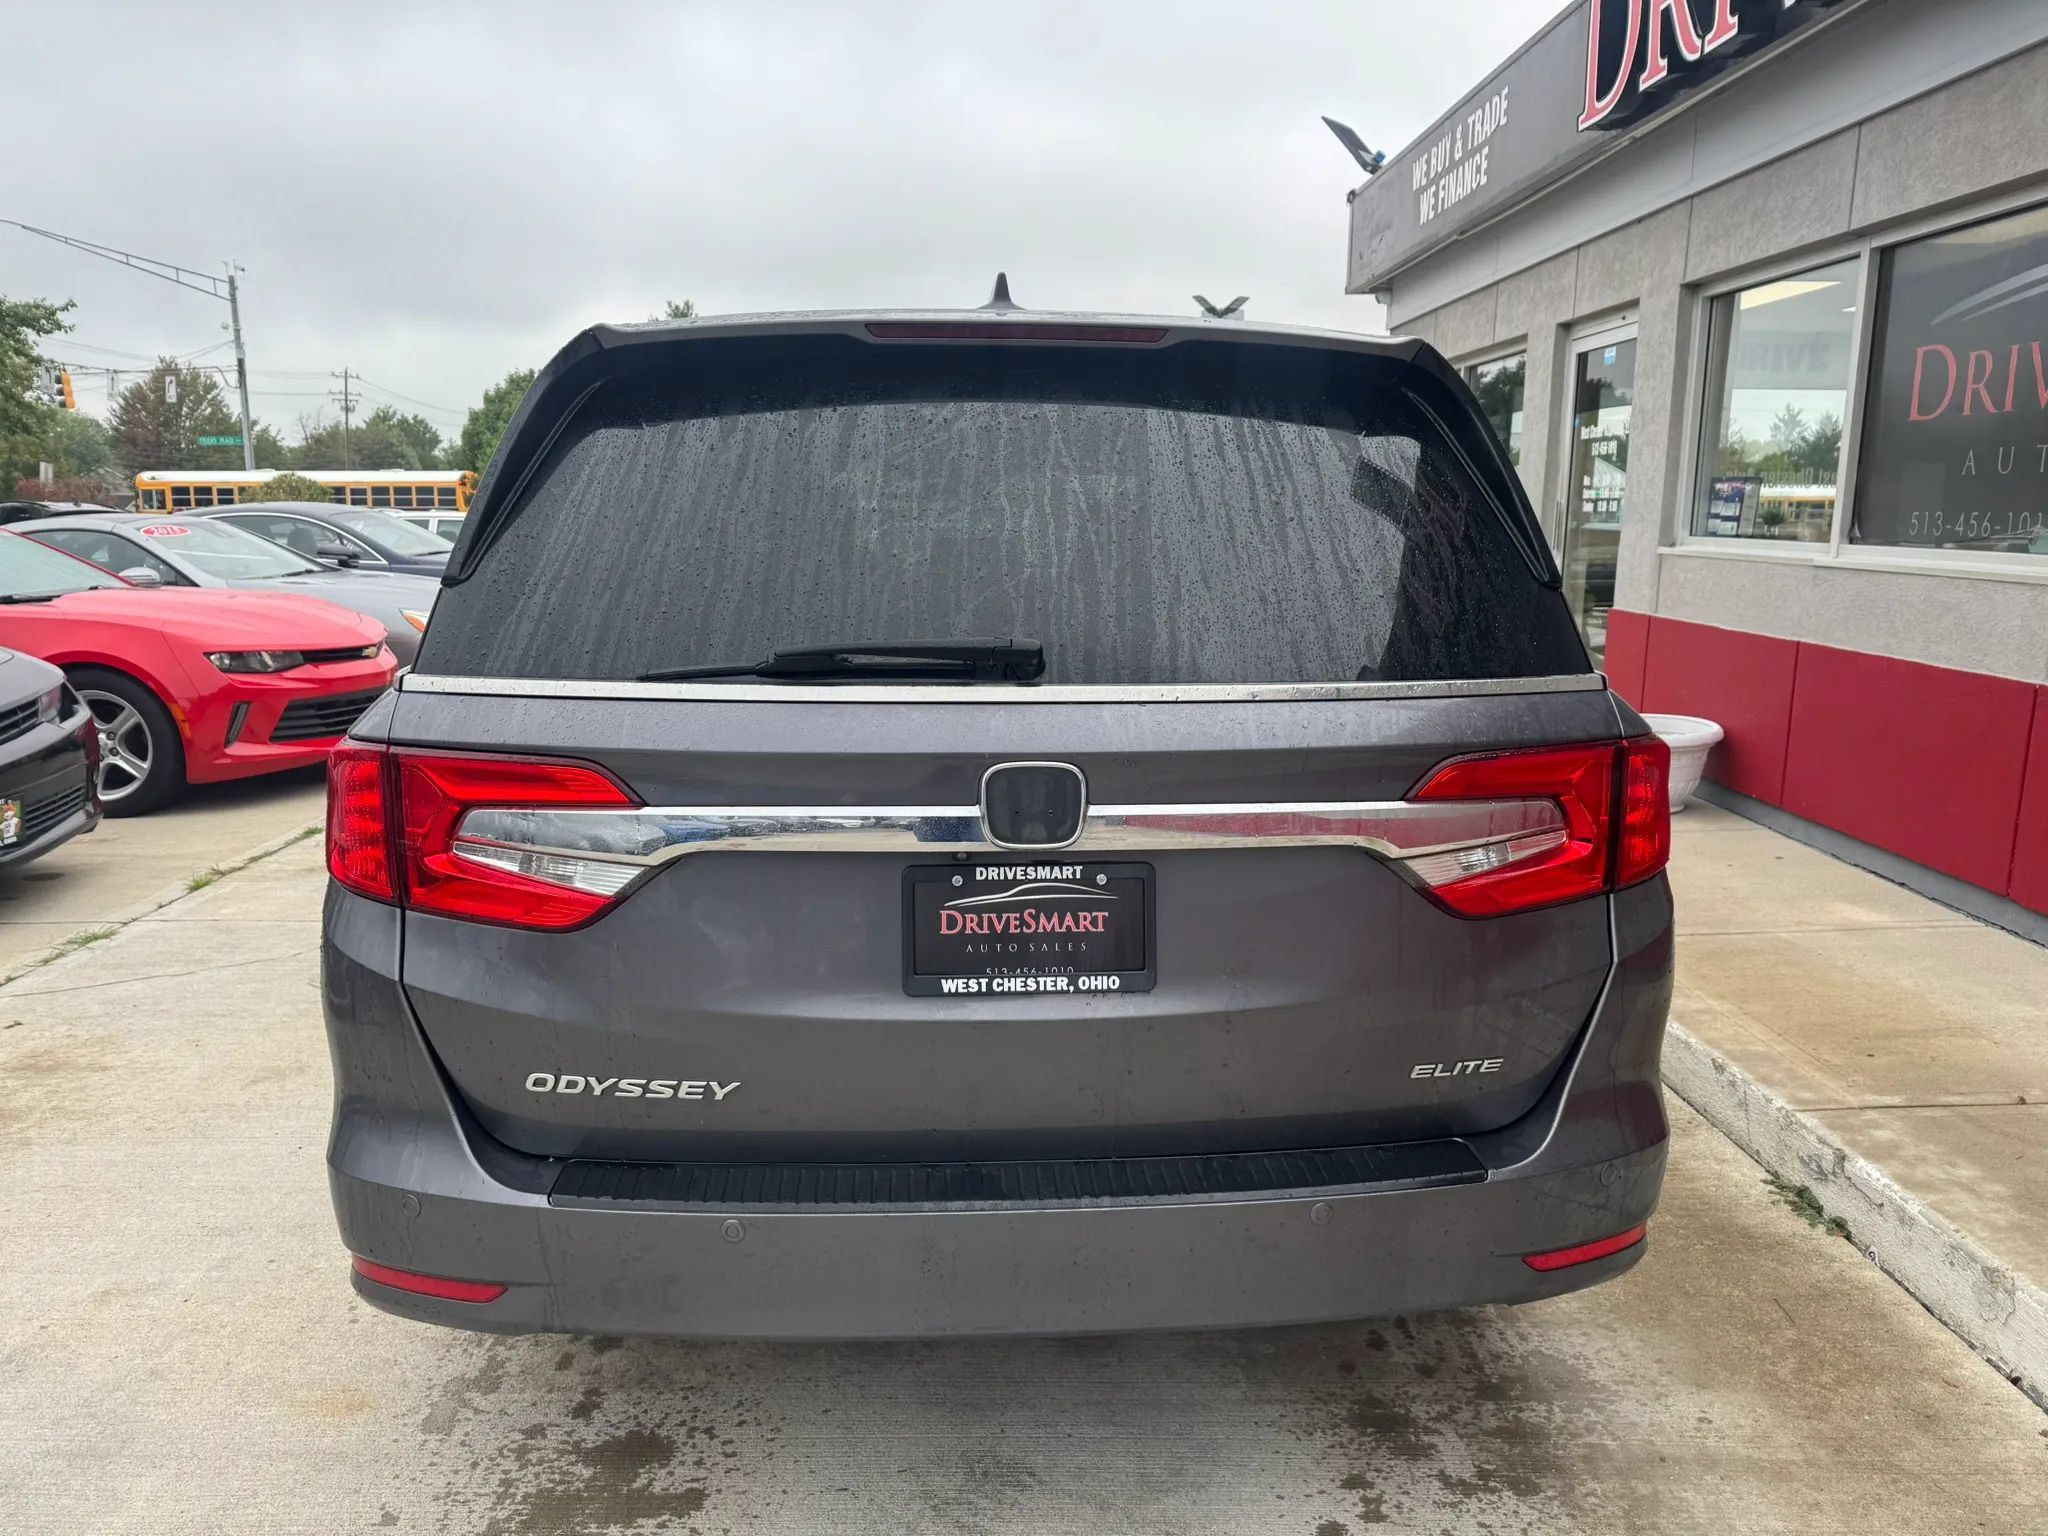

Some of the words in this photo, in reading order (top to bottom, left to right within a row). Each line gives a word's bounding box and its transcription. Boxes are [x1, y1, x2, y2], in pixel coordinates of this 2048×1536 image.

[1412, 153, 1428, 191] WE
[1429, 131, 1452, 179] BUY
[1454, 123, 1463, 161] &
[1467, 84, 1509, 150] TRADE
[1419, 184, 1437, 226] WE
[1437, 145, 1489, 214] FINANCE
[975, 865, 1083, 881] DRIVESMART
[966, 943, 1018, 953] AUTO
[1029, 941, 1086, 952] SALES
[941, 978, 989, 994] WEST
[992, 976, 1074, 994] CHESTER,
[1078, 975, 1120, 991] OHIO
[1410, 1058, 1505, 1079] ELITE
[525, 1072, 742, 1101] ODYSSEY
